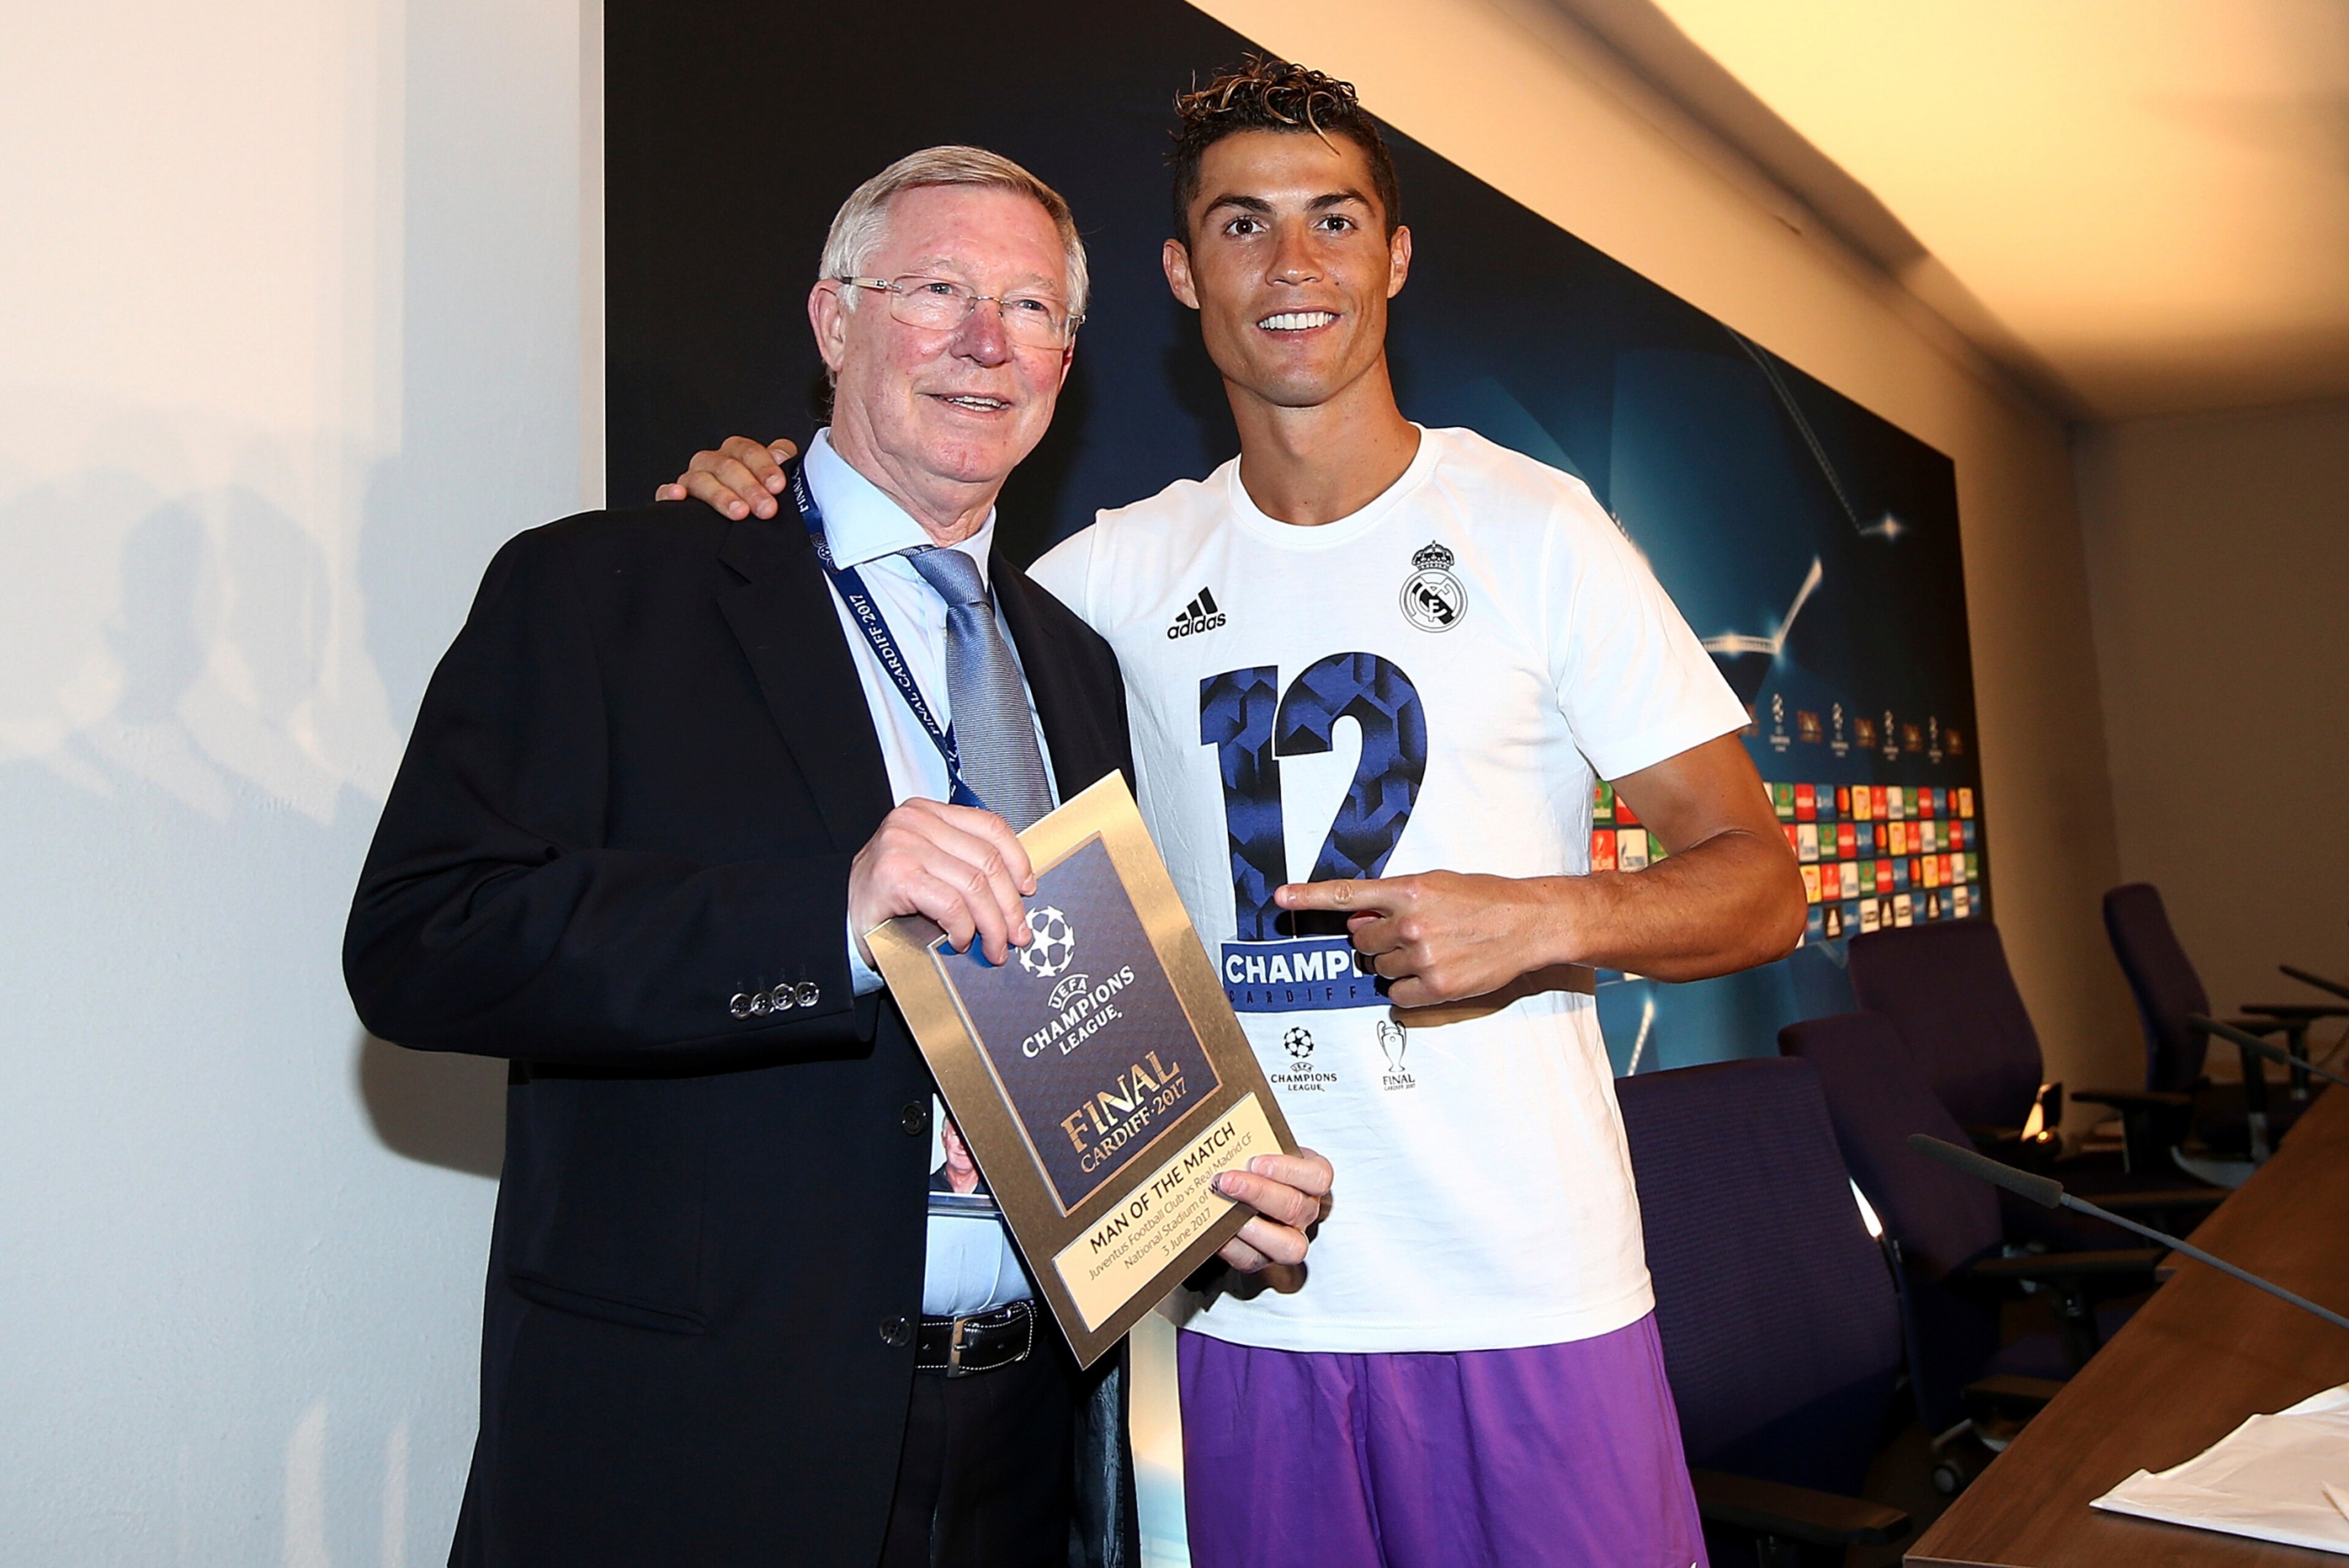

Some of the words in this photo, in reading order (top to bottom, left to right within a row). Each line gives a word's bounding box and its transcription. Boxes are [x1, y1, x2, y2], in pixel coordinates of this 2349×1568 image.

[1167, 613, 1226, 639] adidas
[1200, 652, 1428, 940] 12
[1052, 978, 1086, 1009] UEFA
[1225, 949, 1363, 984] CHAMPI
[1022, 965, 1135, 1058] CHAMPIONS
[1061, 1050, 1180, 1153] FINAL
[1271, 1072, 1337, 1083] CHAMPIONS
[1382, 1074, 1416, 1085] FINAL
[1089, 1240, 1129, 1280] Juventus
[1127, 1209, 1165, 1241] Football
[1163, 1193, 1185, 1214] Club
[1186, 1183, 1195, 1196] vs
[1195, 1166, 1214, 1189] Real
[1212, 1142, 1243, 1171] Madrid
[1242, 1131, 1253, 1146] CF
[1090, 1213, 1129, 1254] MAN
[1130, 1192, 1150, 1219] OF
[1151, 1165, 1184, 1198] THE
[1183, 1121, 1236, 1173] MATCH
[1124, 1231, 1162, 1269] National
[1162, 1202, 1199, 1233] Stadium
[1199, 1189, 1209, 1203] of
[1170, 1227, 1192, 1252] June
[1192, 1207, 1212, 1232] 2017
